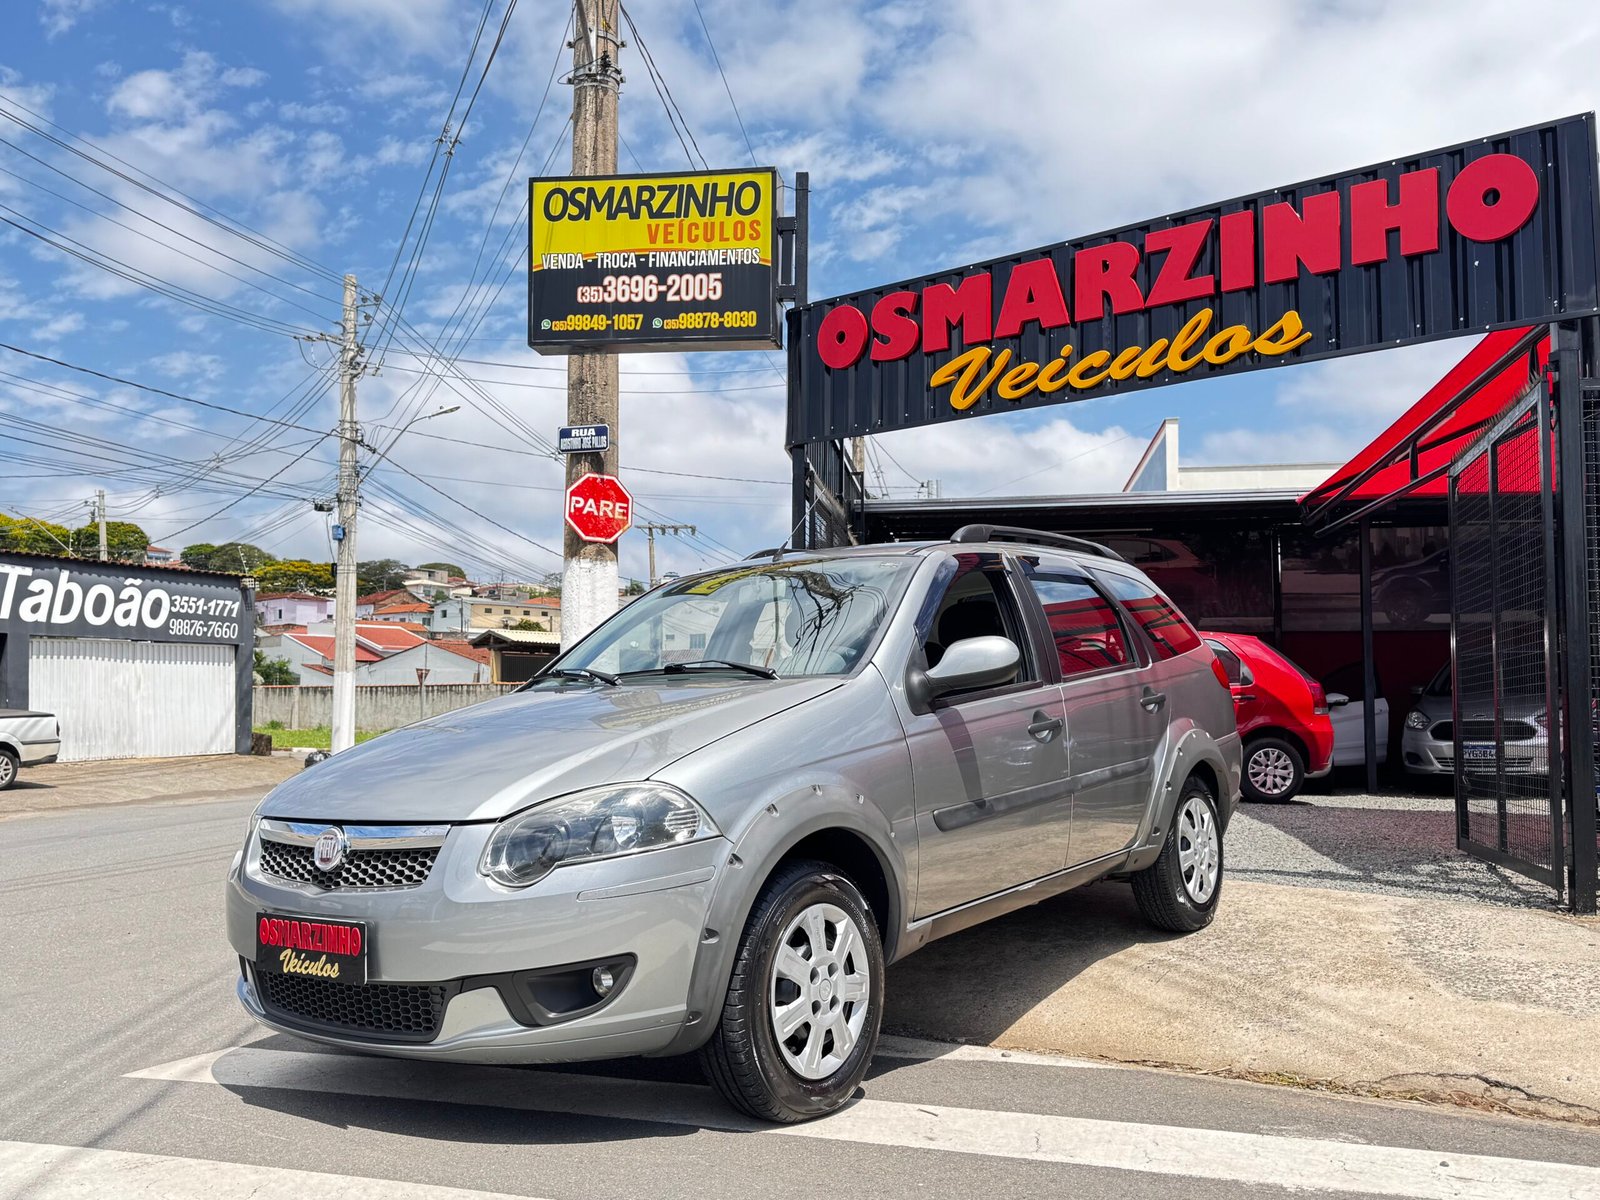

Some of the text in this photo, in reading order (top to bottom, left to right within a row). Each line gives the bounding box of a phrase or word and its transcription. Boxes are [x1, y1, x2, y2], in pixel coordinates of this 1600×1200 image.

[543, 181, 761, 221] OSMARZINHO
[648, 219, 761, 244] VEÍCULOS
[541, 253, 584, 270] VENDA
[596, 252, 636, 269] TROCA
[648, 248, 760, 268] FINANCIAMENTOS
[816, 152, 1540, 370] OSMARZINHO
[929, 307, 1313, 411] Veiculos
[571, 428, 596, 437] RUA
[570, 496, 628, 520] PARE
[0, 564, 170, 629] Taboão
[260, 918, 361, 957] OSMARZINHO
